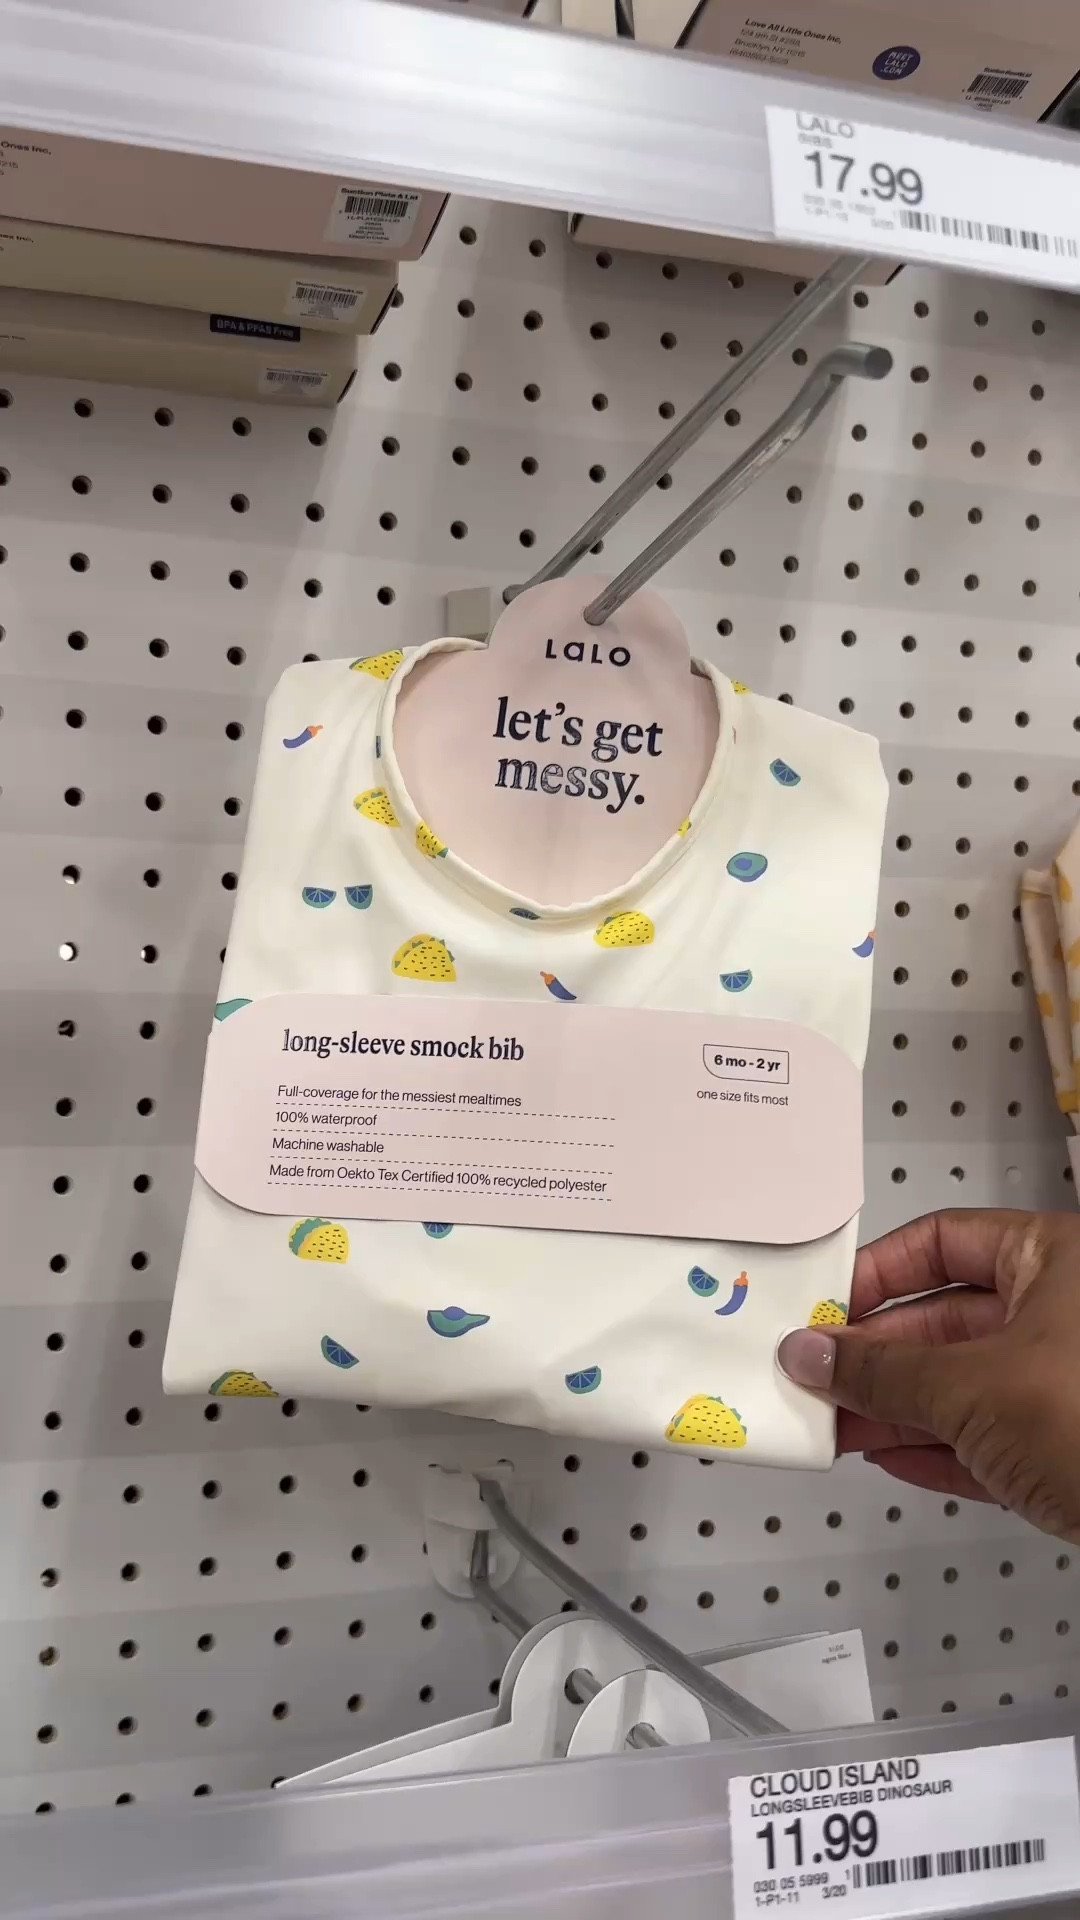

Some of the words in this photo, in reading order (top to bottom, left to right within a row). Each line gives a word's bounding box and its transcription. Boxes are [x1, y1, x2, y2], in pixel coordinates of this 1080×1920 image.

[745, 18, 767, 28] Love
[767, 23, 780, 31] All
[780, 25, 803, 36] Little
[804, 30, 826, 40] Ones
[796, 111, 854, 139] LALO
[804, 150, 923, 205] 17.99
[591, 720, 664, 763] get
[495, 757, 645, 814] messy.
[282, 1028, 405, 1059] long-sleeve
[410, 1035, 485, 1058] smock
[488, 1036, 525, 1061] bib
[714, 1054, 723, 1066] 6
[725, 1057, 747, 1067] mo
[756, 1058, 765, 1069] 2
[767, 1061, 781, 1072] yr
[277, 1085, 359, 1101] Full-coverage
[361, 1088, 378, 1100] for
[380, 1089, 400, 1101] the
[402, 1091, 456, 1103] messiest
[458, 1093, 522, 1107] mealtimes
[696, 1090, 718, 1100] one
[719, 1091, 741, 1102] size
[743, 1092, 760, 1104] fits
[761, 1095, 789, 1106] most
[275, 1111, 309, 1124] 100%
[311, 1114, 378, 1127] waterproof
[272, 1137, 324, 1151] Machine
[326, 1140, 385, 1153] washable
[269, 1164, 304, 1178] Made
[306, 1165, 335, 1178] from
[337, 1167, 375, 1180] Oekto
[377, 1168, 399, 1181] Tex
[401, 1169, 455, 1184] Certified
[456, 1172, 491, 1186] 100%
[493, 1175, 547, 1190] recycled
[549, 1178, 608, 1192] polyester
[750, 1768, 832, 1798] CLOUD
[838, 1757, 920, 1788] ISLAND
[751, 1790, 874, 1818] LONGSLEEVEBIB
[877, 1779, 953, 1802] DINOSAUR
[756, 1809, 878, 1870] 11.99
[753, 1879, 776, 1894] 030
[780, 1876, 795, 1890] 05
[799, 1872, 829, 1888] 5999
[822, 1884, 847, 1899] 3/20
